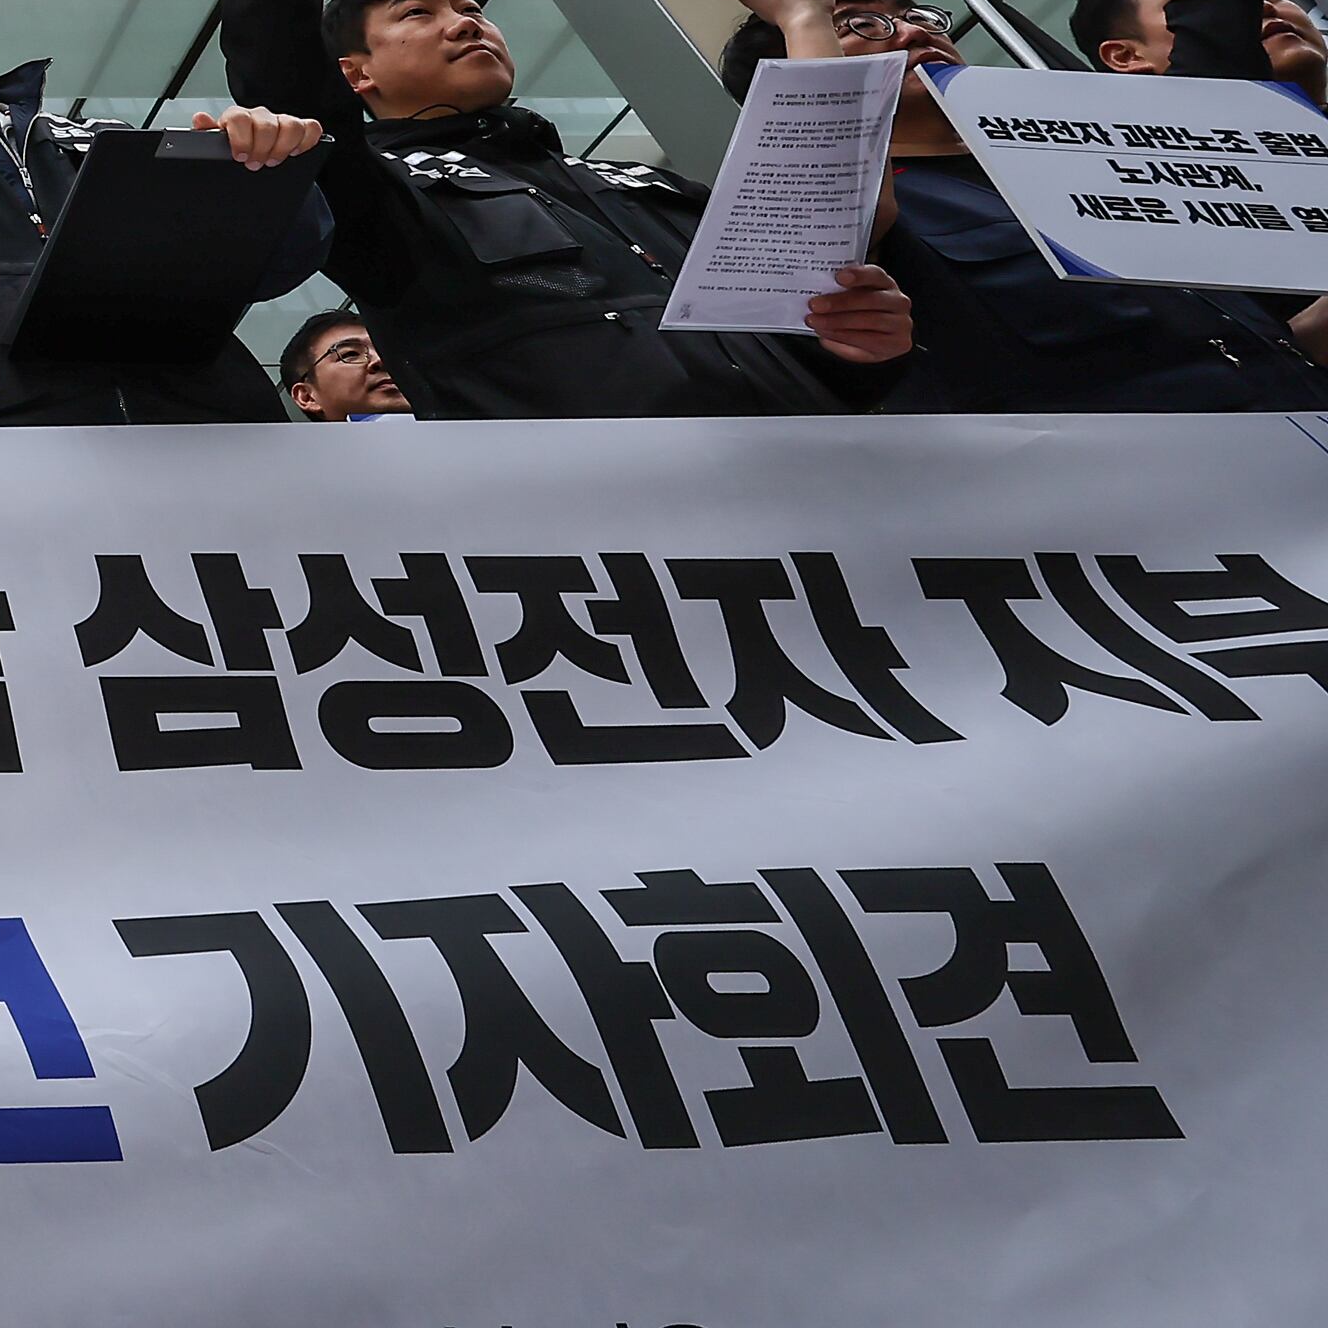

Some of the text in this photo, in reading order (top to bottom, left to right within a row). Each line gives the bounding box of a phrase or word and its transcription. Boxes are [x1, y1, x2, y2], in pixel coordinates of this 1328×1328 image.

[978, 117, 1328, 157] 삼성전자 과반노조 출범
[1070, 194, 1328, 232] 새로운 시대를 열
[74, 552, 966, 771] 삼성전자
[915, 552, 1328, 726] 지부
[113, 863, 1185, 1154] 기자회견
